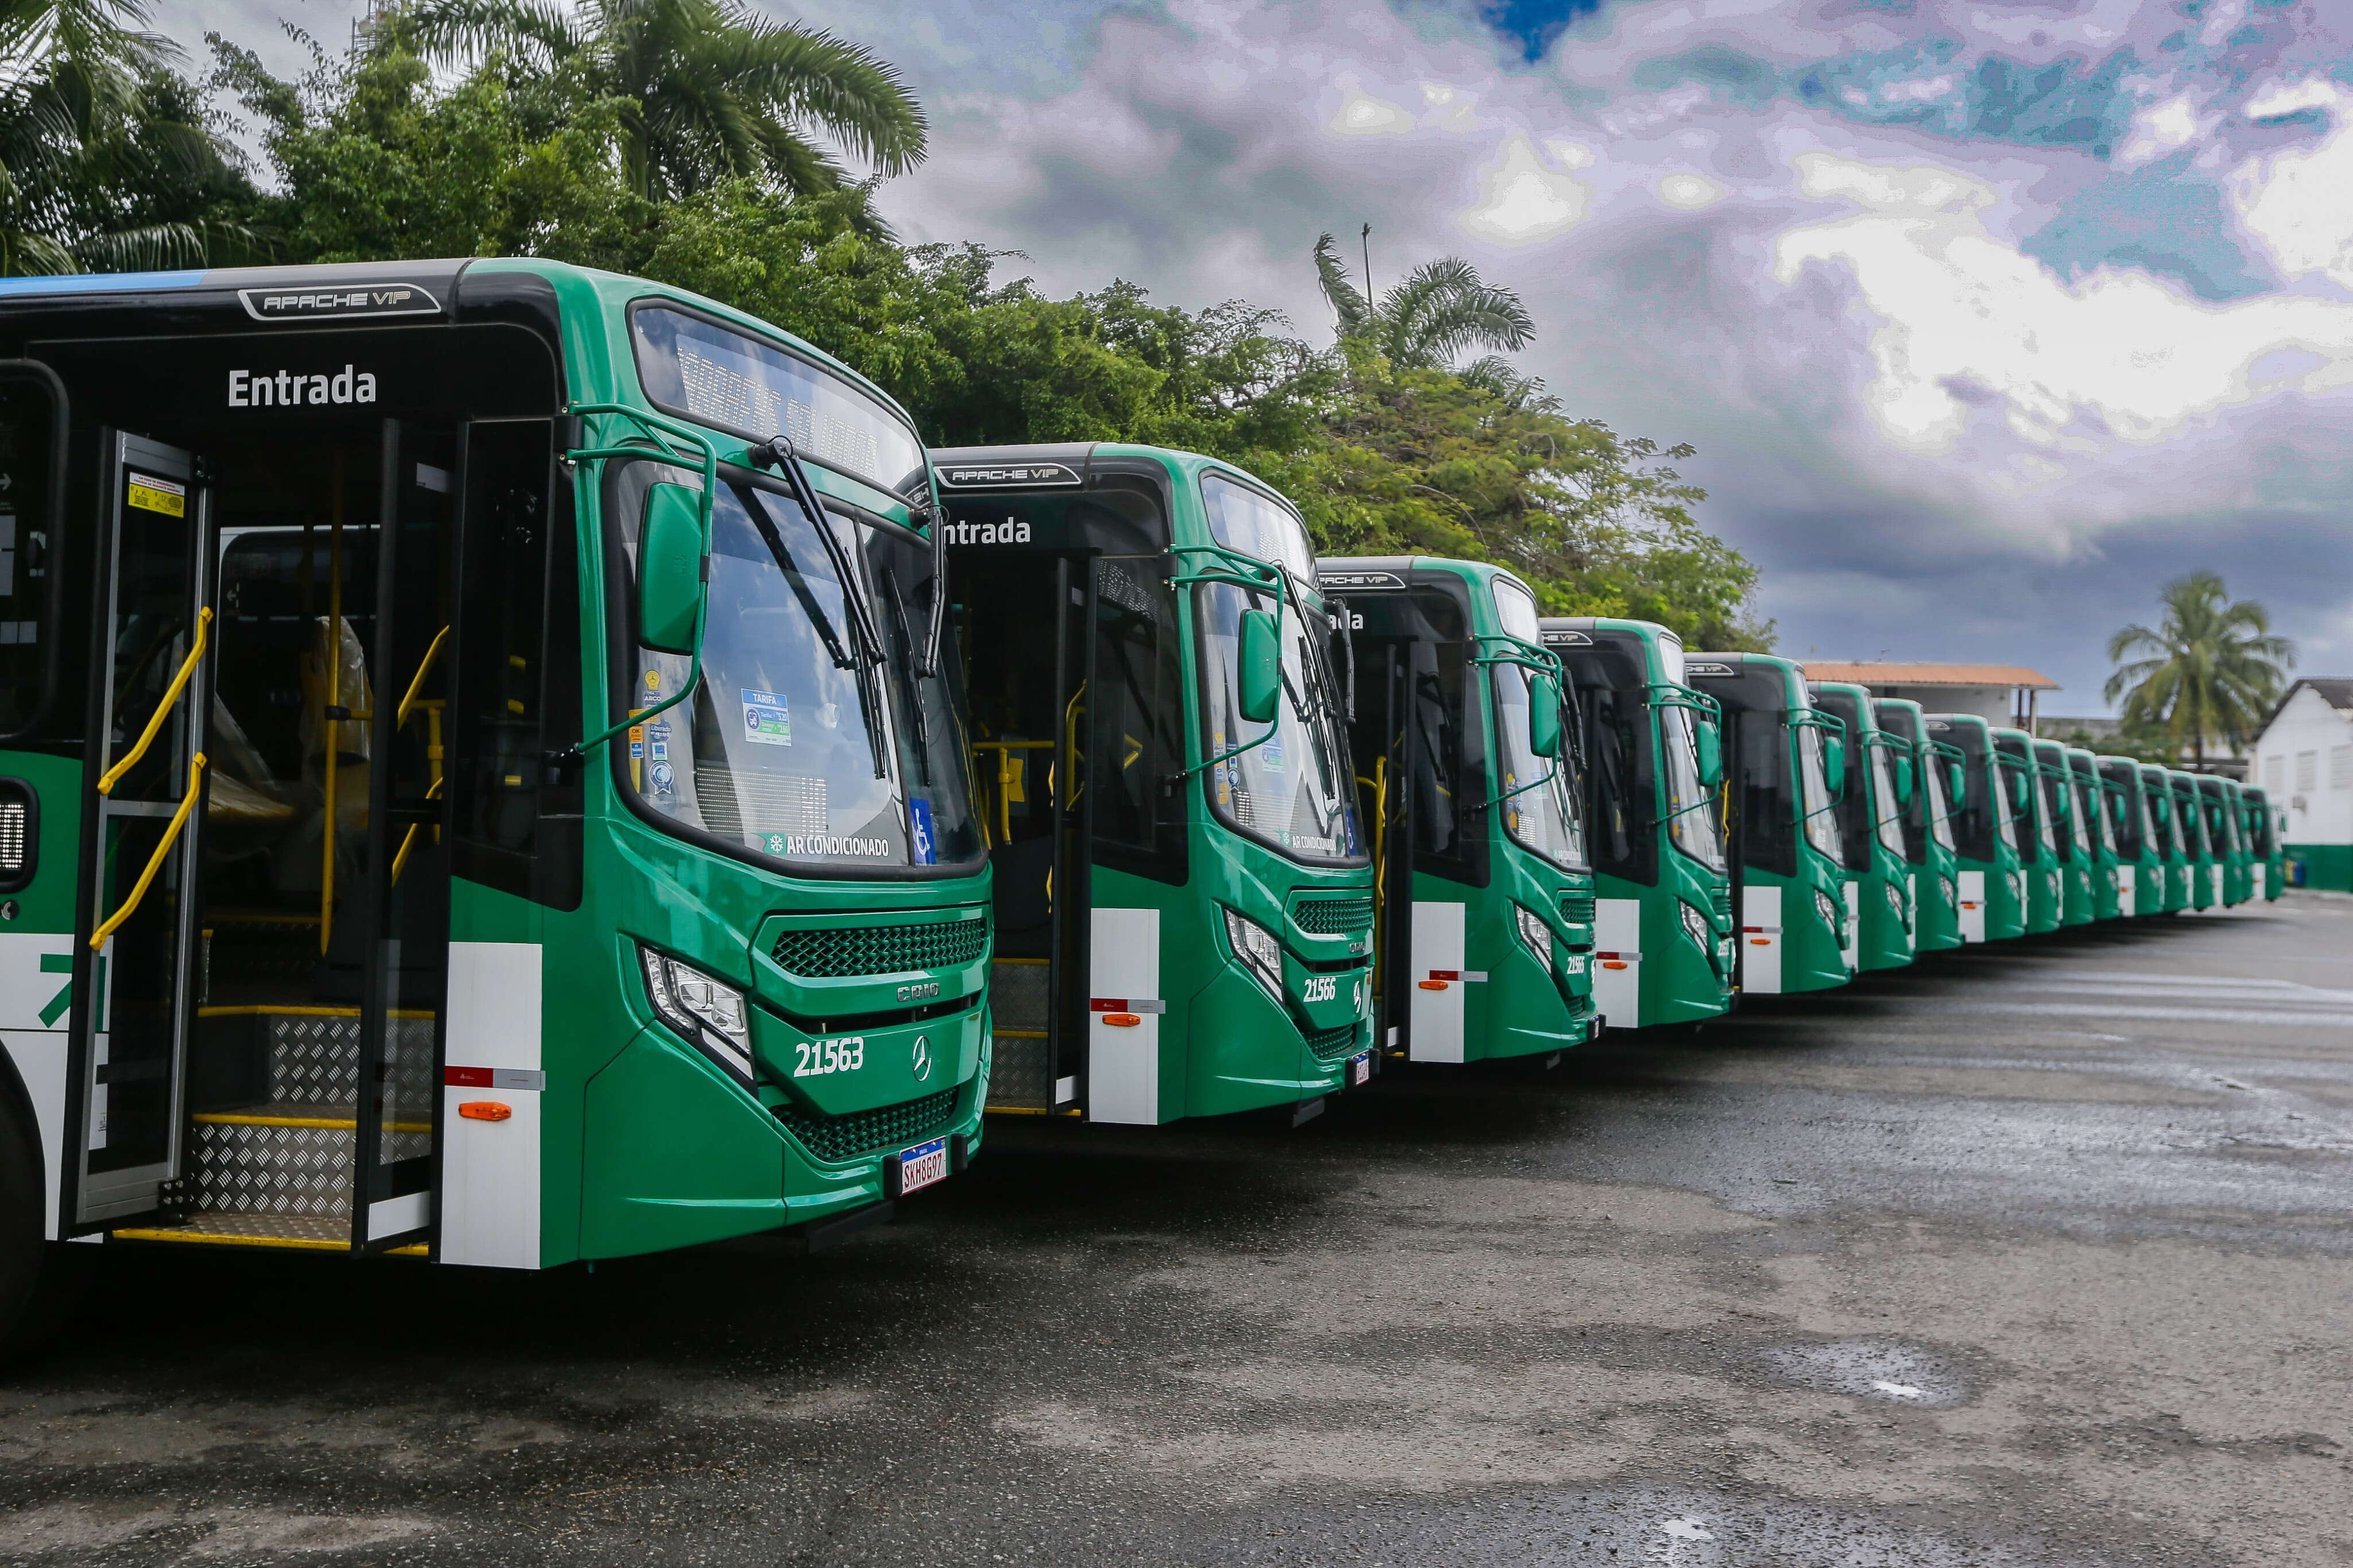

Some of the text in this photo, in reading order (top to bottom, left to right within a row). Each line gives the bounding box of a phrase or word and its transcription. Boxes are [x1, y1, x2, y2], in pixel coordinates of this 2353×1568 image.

[264, 291, 411, 310] APACHE VIP
[229, 364, 376, 407] Entrada
[952, 469, 1059, 480] APACHE VIP
[943, 517, 1031, 544] ntrada
[753, 693, 777, 705] TARIFA
[786, 836, 889, 856] AR CONDICIONADO
[1293, 836, 1301, 848] AR
[1303, 977, 1336, 1002] 21566
[794, 1037, 864, 1077] 21563
[904, 1153, 942, 1188] SKH8G97
